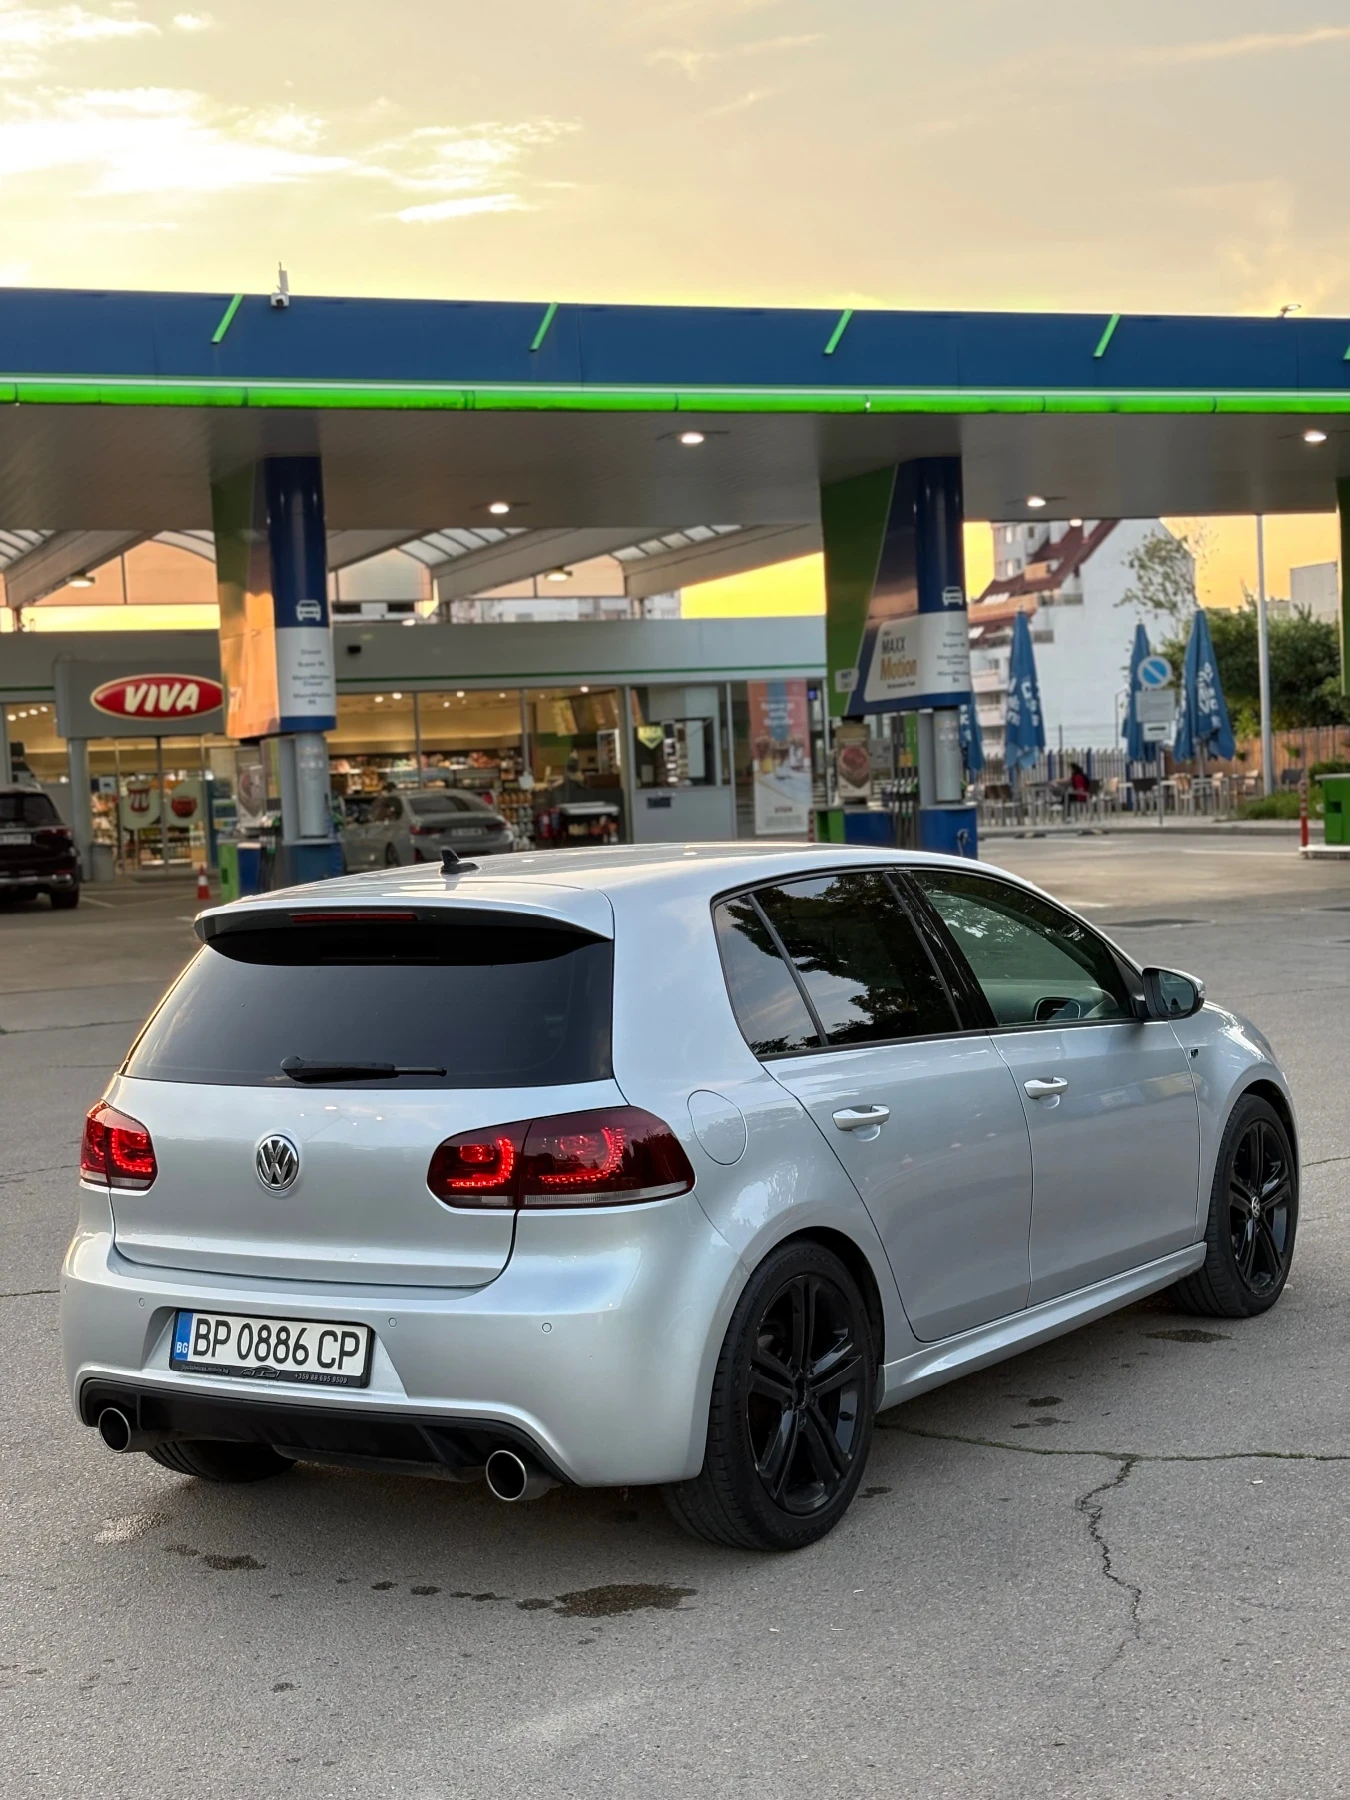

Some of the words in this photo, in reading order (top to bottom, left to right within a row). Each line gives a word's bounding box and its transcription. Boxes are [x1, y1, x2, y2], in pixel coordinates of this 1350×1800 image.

[881, 635, 906, 654] MAXX
[880, 655, 917, 681] Motion
[124, 682, 199, 713] VIVA
[175, 1341, 188, 1354] BG
[193, 1318, 231, 1357] BP
[237, 1322, 309, 1365] 0886
[317, 1329, 360, 1370] CP
[319, 1374, 331, 1382] 695
[332, 1376, 348, 1384] 9509
